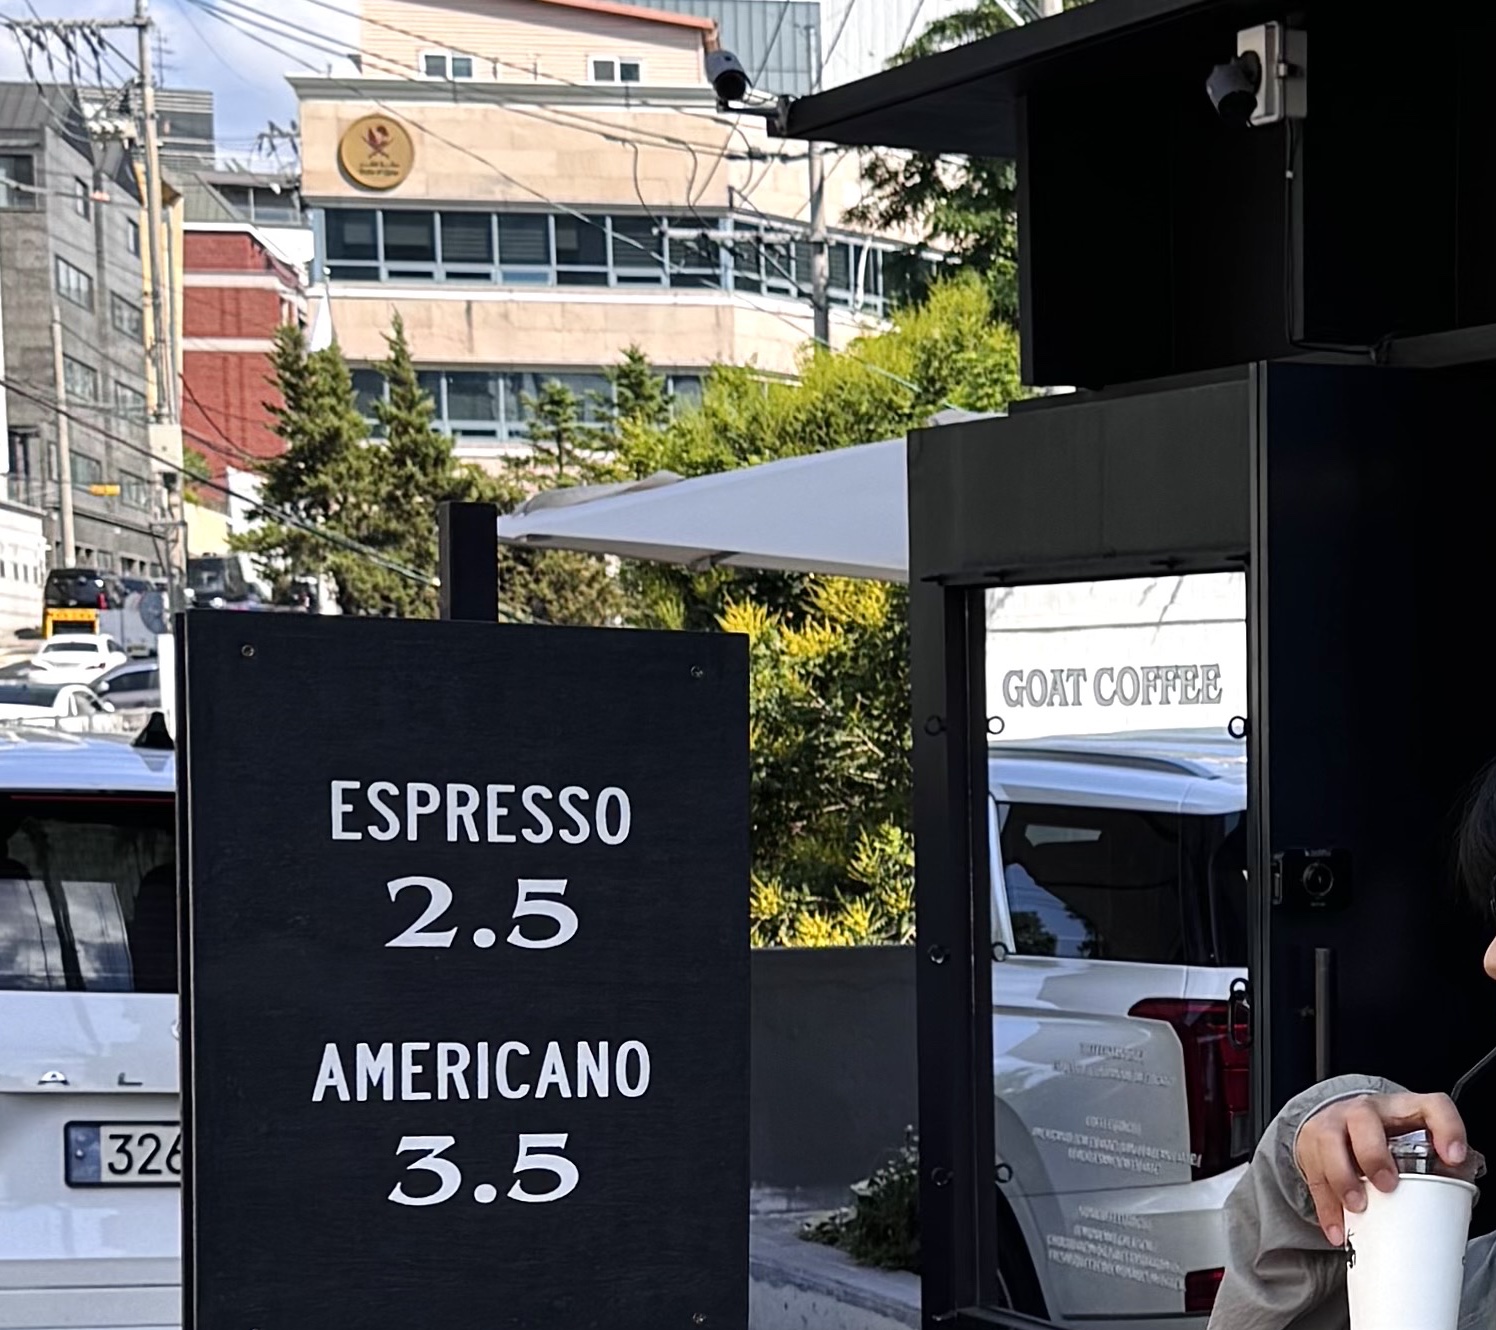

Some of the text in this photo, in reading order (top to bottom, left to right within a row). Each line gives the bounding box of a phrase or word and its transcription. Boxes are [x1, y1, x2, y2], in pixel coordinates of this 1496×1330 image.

[1002, 663, 1223, 707] GOAT COFFEE
[330, 780, 632, 845] ESPRESSO
[384, 876, 580, 949] 2.5
[312, 1040, 651, 1102] AMERICANO
[107, 1133, 182, 1175] 326
[387, 1132, 581, 1206] 3.5
